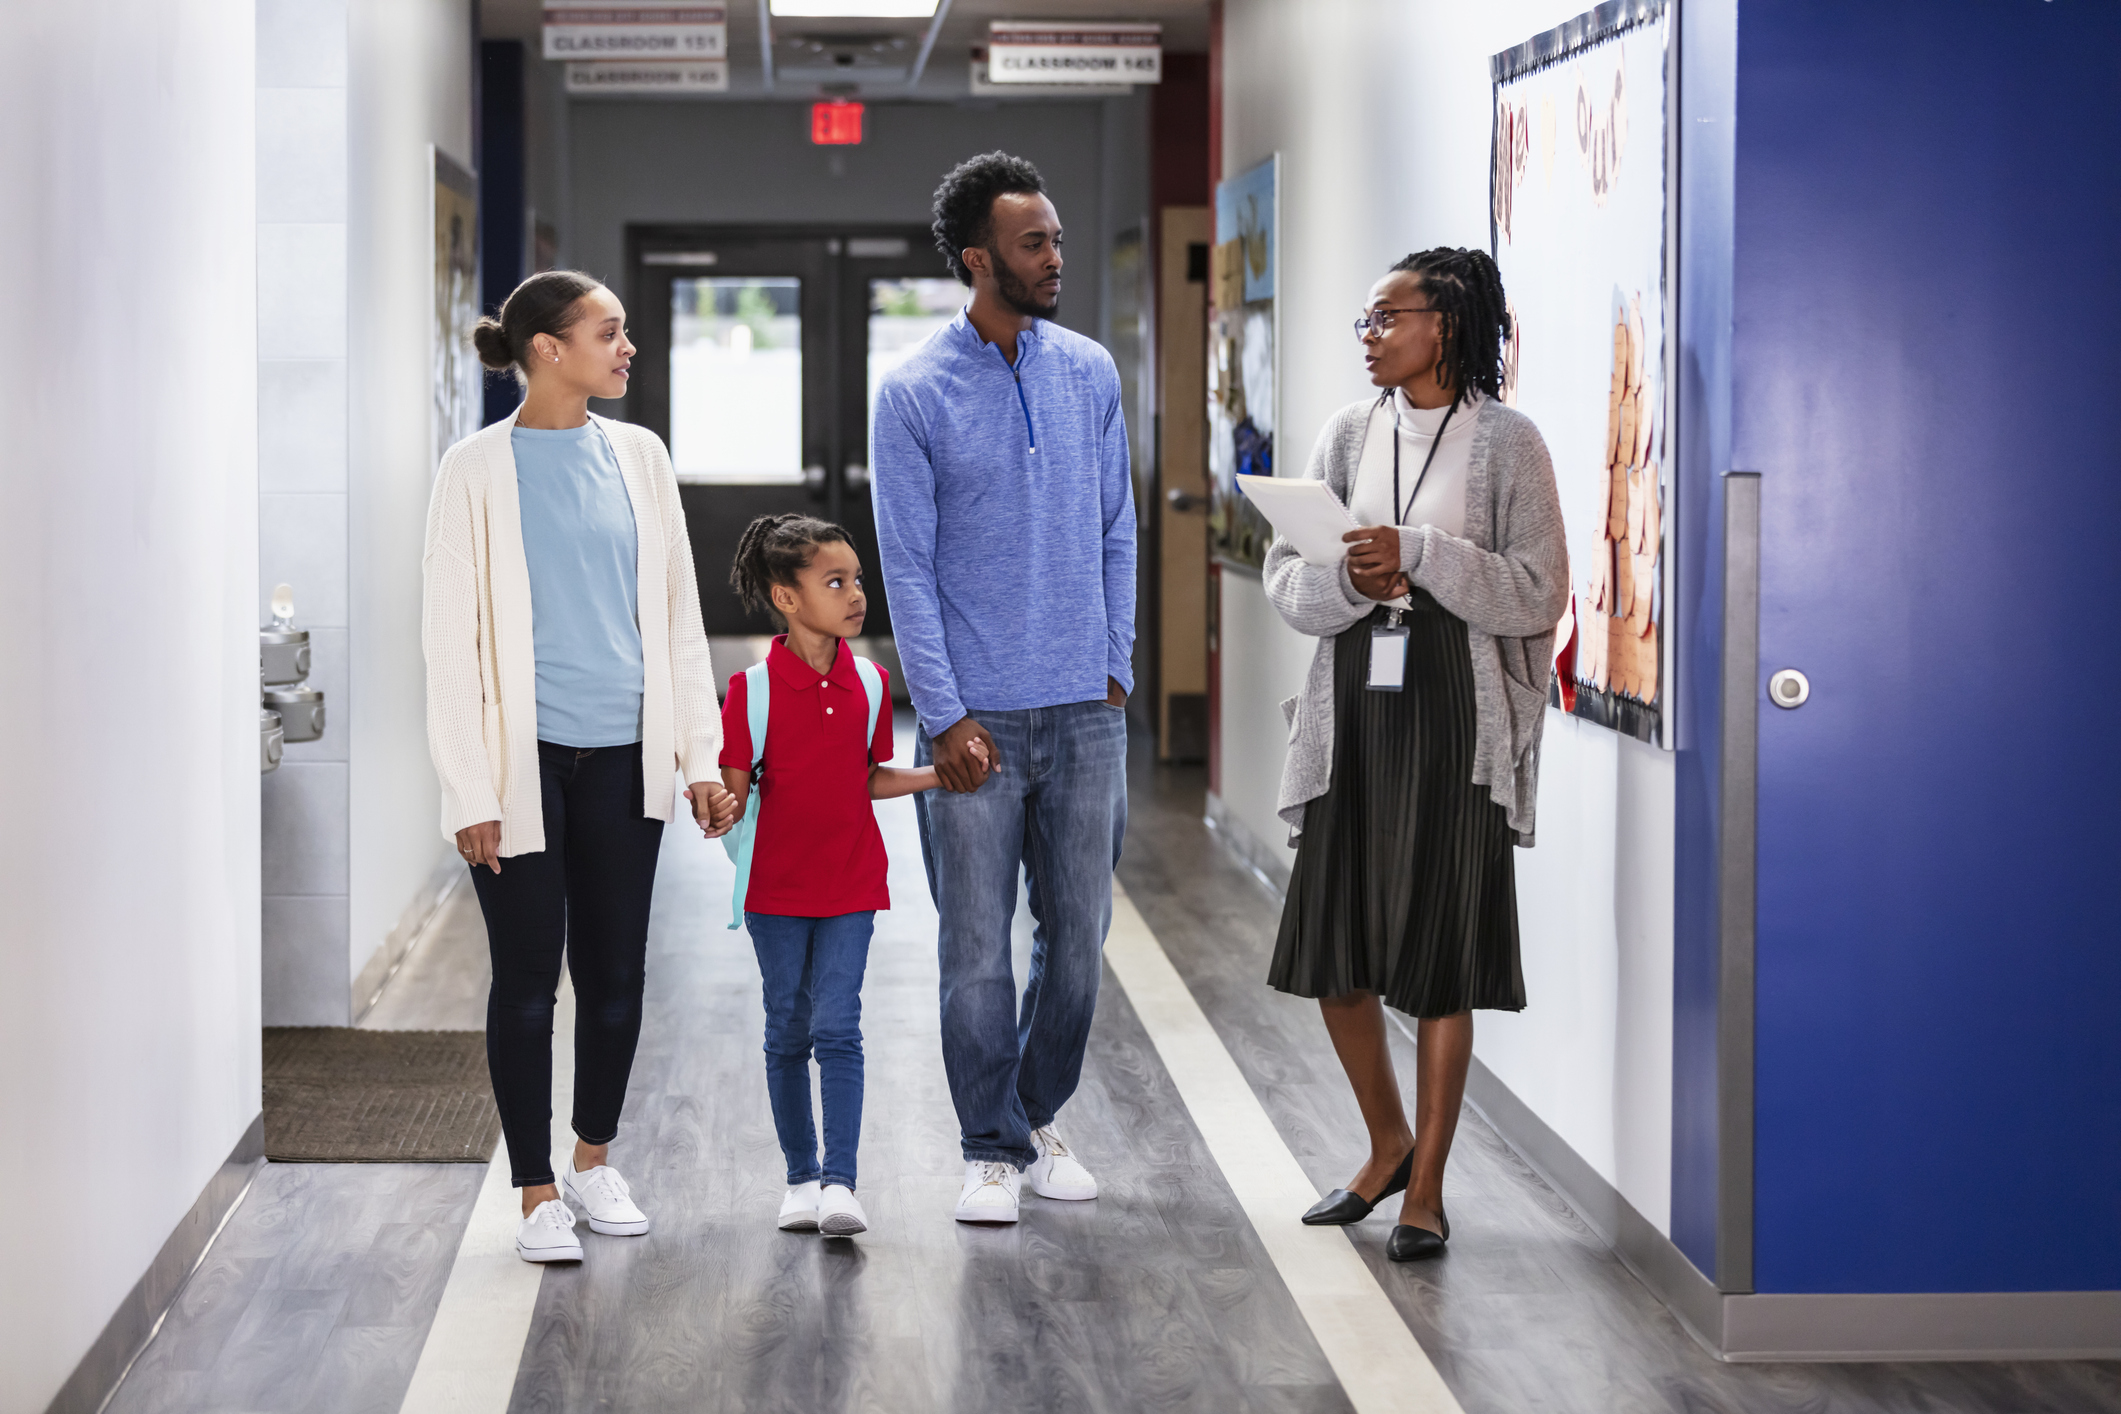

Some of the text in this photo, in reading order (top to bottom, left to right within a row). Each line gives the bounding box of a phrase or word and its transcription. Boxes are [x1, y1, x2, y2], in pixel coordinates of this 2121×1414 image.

[553, 36, 718, 52] CLASSROOM 151
[1001, 57, 1157, 72] CLASSROOM 145
[1576, 68, 1624, 197] our
